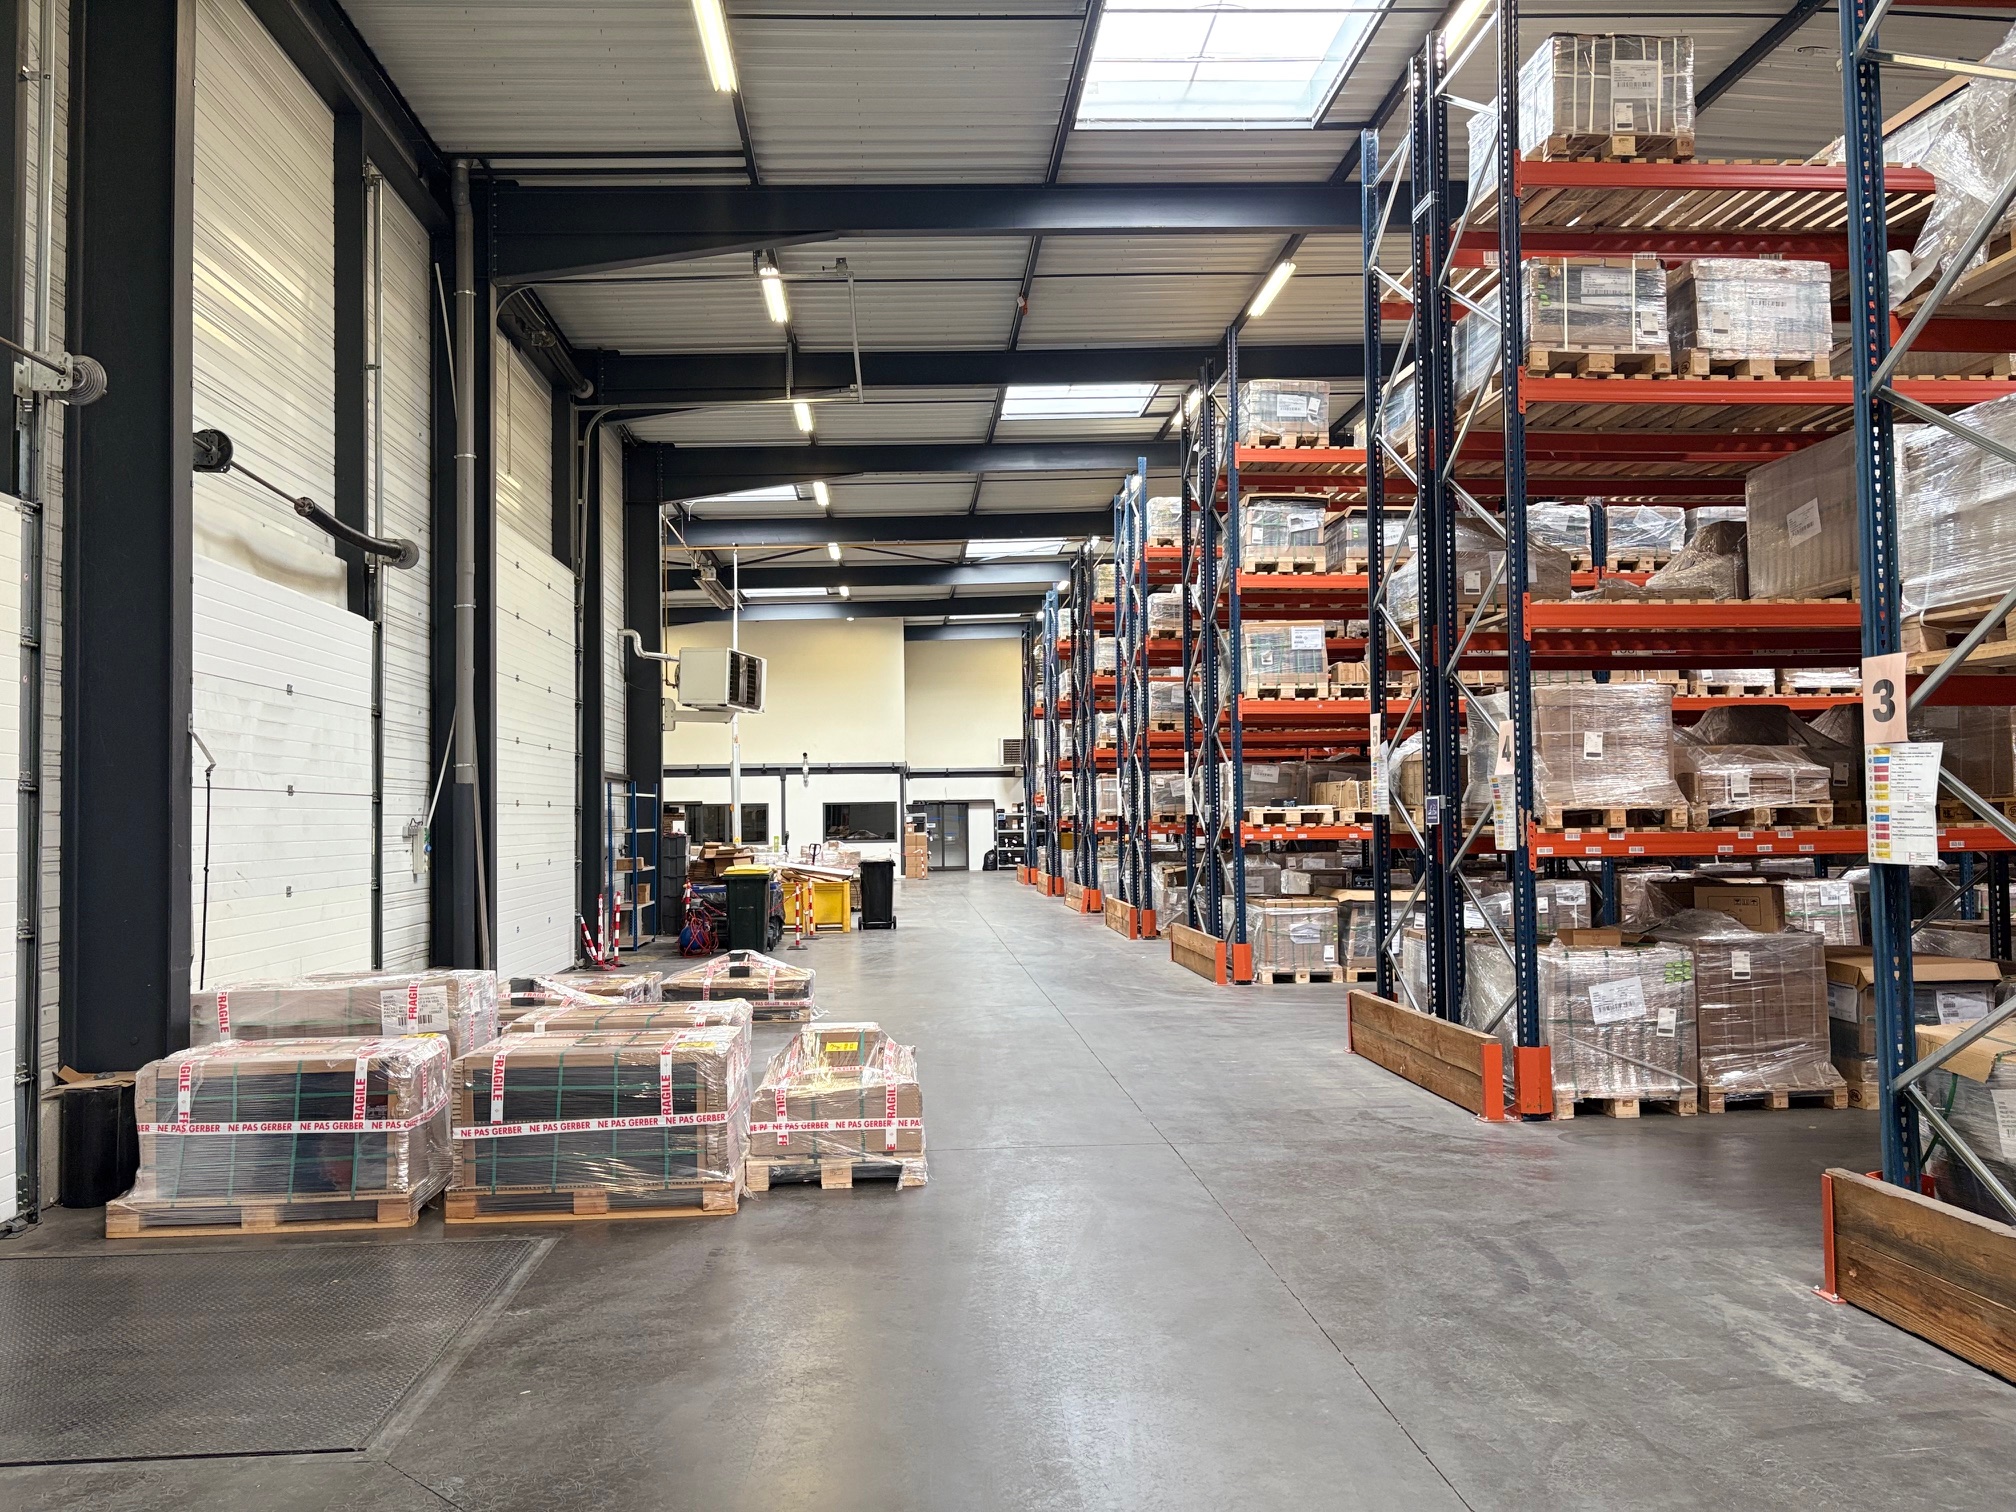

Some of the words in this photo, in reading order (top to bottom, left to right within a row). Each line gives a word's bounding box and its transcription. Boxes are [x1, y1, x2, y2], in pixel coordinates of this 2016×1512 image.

[1872, 679, 1896, 723] 3
[1372, 726, 1378, 747] 5
[1502, 735, 1512, 762] 4
[218, 992, 230, 1033] FRAGILE
[408, 982, 419, 1020] FRAGIL
[180, 1064, 191, 1092] GILE
[493, 1055, 504, 1101] FRAGILE
[662, 1075, 672, 1115] RAGILE
[354, 1078, 366, 1120] RAGILE
[260, 1123, 292, 1131] GERBER
[332, 1122, 364, 1130] GERBER
[386, 1121, 400, 1129] PAS
[492, 1126, 522, 1135] GERBER
[543, 1123, 558, 1131] PAS
[560, 1122, 590, 1130] GERBER
[628, 1118, 658, 1126] GERBER
[696, 1114, 726, 1123] GERBER
